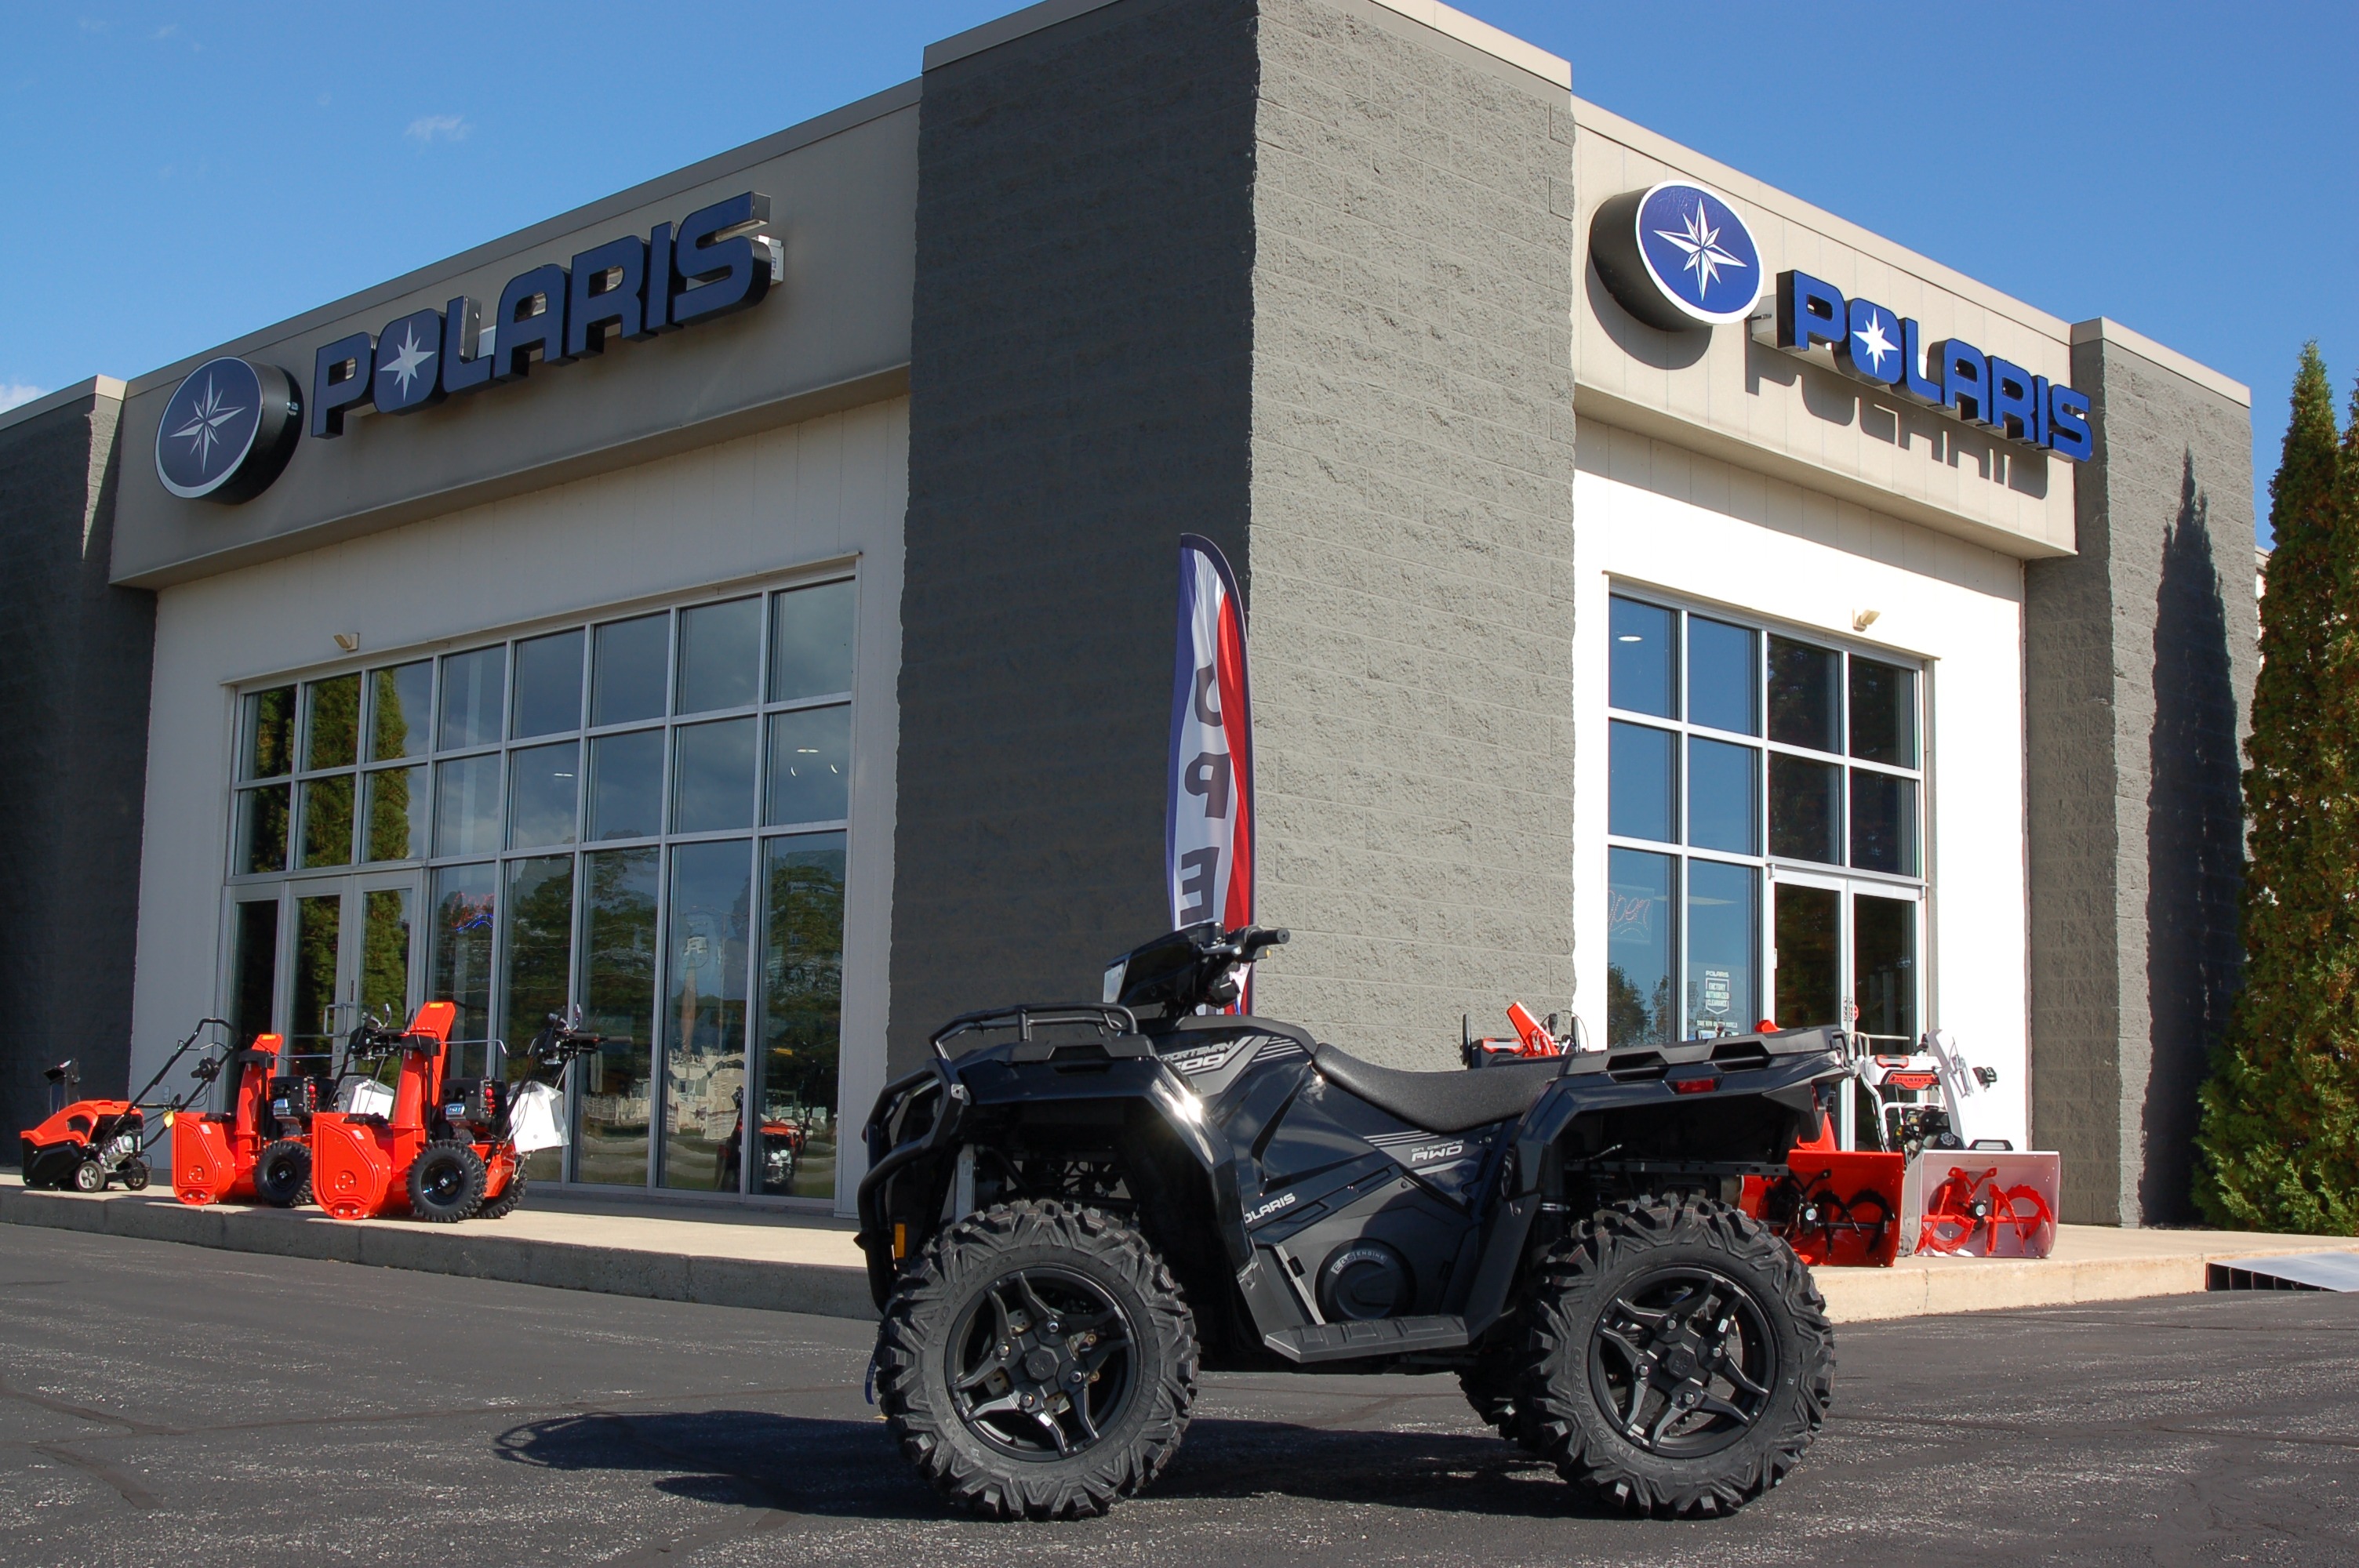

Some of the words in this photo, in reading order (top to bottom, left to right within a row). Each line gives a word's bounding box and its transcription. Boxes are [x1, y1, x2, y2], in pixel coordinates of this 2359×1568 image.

[311, 191, 756, 437] POLARIS
[1785, 270, 2093, 463] POLARIS
[1412, 1145, 1463, 1162] AWD
[1244, 1192, 1296, 1224] OLARIS
[1333, 1254, 1355, 1272] EBS
[1571, 1346, 1612, 1444] DURO
